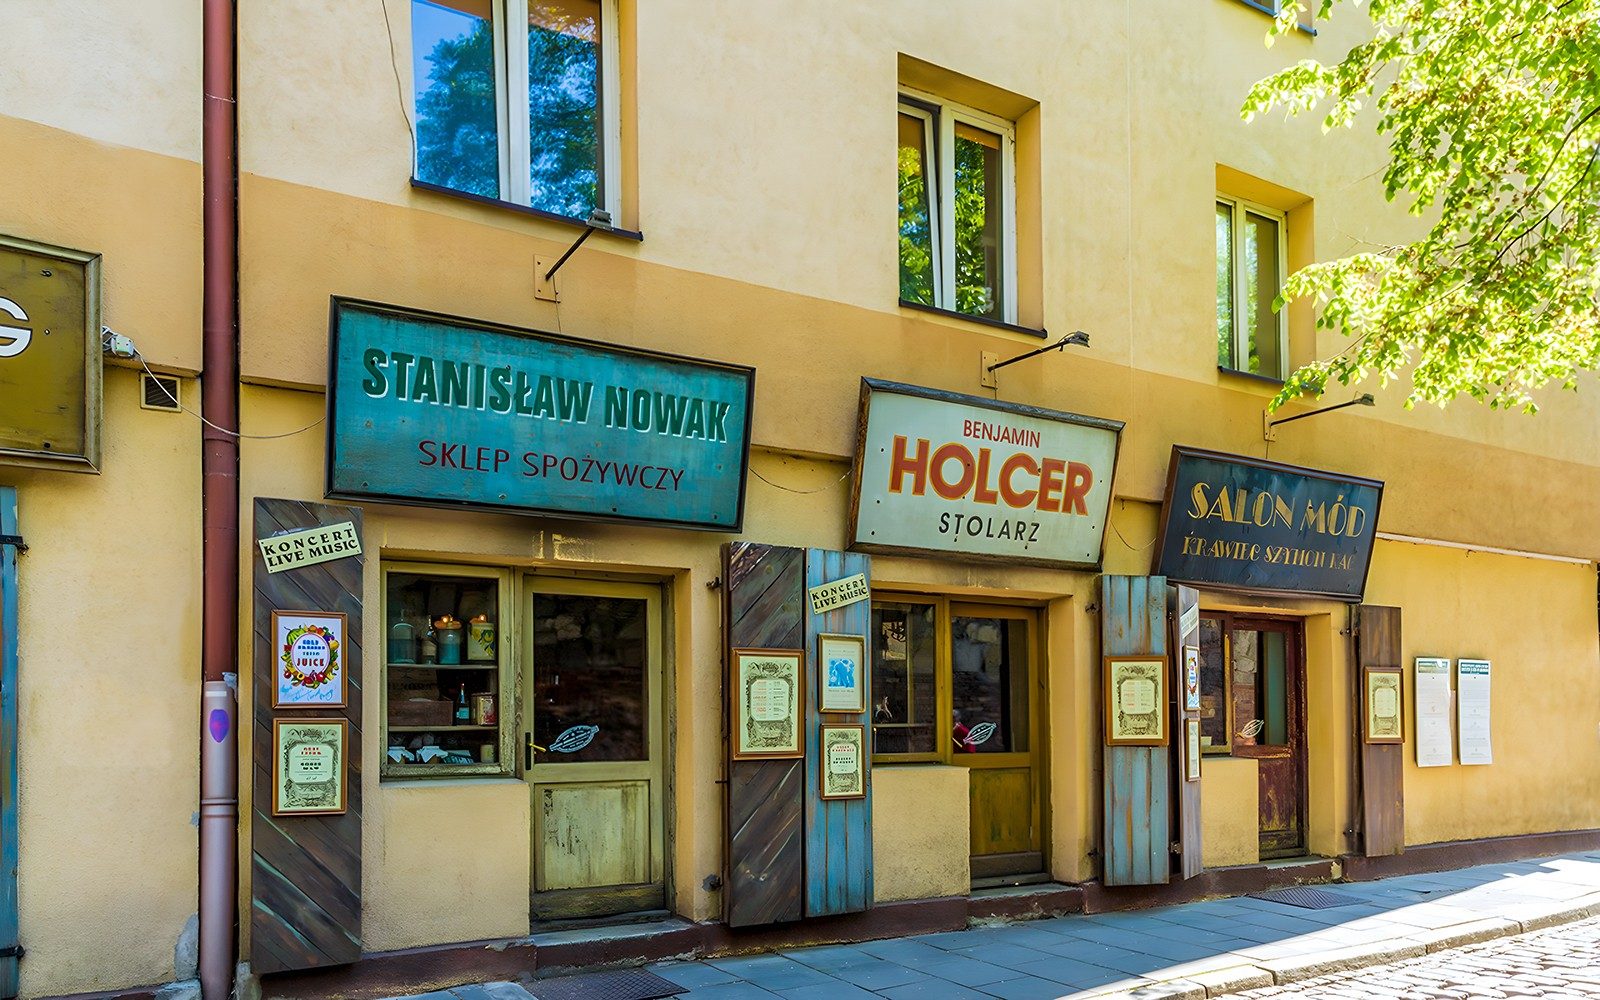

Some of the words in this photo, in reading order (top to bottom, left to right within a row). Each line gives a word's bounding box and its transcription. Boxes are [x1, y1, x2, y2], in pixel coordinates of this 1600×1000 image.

[362, 348, 594, 424] STANISŁAW
[604, 385, 731, 443] NOWAK
[963, 419, 1041, 448] BENJAMIN
[418, 440, 510, 473] SKLEP
[522, 452, 684, 491] SPOŻYWCZY
[888, 434, 1094, 517] HOLCER
[1187, 482, 1296, 530] SALON
[1300, 494, 1366, 538] MÓD
[938, 512, 1040, 542] STOLARZ
[263, 529, 353, 556] KONCERT
[267, 550, 304, 567] LIVE
[309, 540, 358, 558] MUSIC
[1181, 535, 1261, 562] KRAWIEC
[812, 578, 865, 601] KONCERT
[814, 596, 837, 609] LIVE
[840, 587, 867, 602] MUSIC
[297, 658, 325, 667] JUICE
